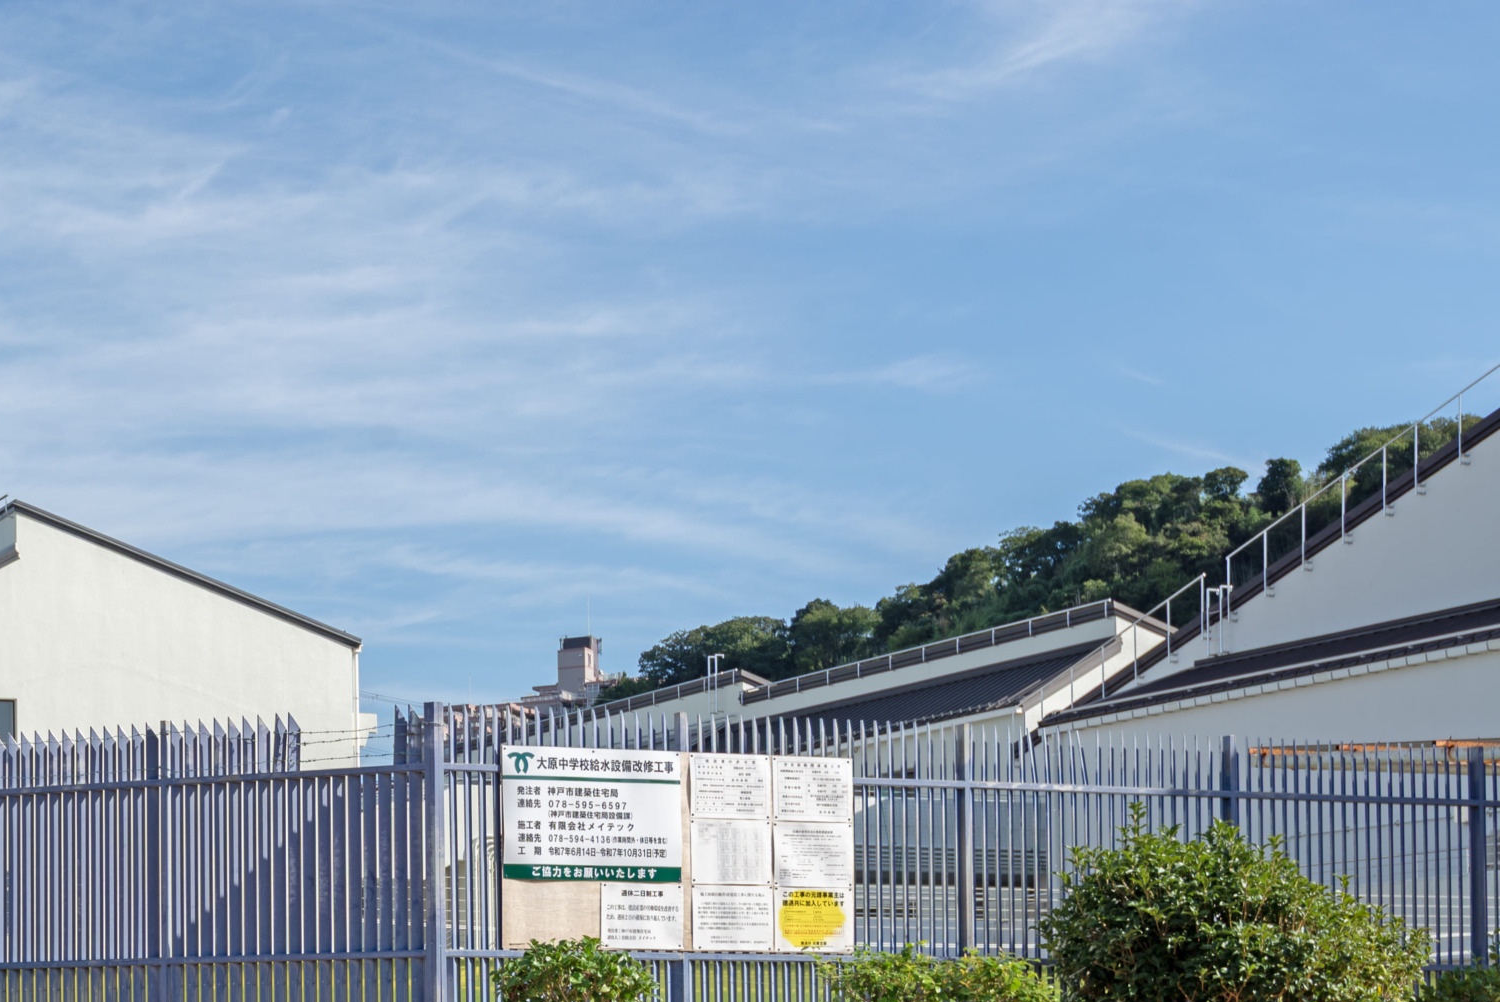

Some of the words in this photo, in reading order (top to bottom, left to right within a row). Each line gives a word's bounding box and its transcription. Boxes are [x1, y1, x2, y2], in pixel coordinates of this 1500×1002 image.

[536, 756, 674, 774] 大原中学校給水設備改修工事
[517, 785, 541, 796] 発注者
[547, 786, 619, 798] 神戸市建築住宅局
[517, 798, 541, 808] 連絡先
[548, 799, 627, 811] 078-595-6597
[517, 820, 541, 830] 施工者
[548, 821, 635, 832] 有限会社メイテック
[517, 833, 542, 843] 連絡先
[532, 866, 658, 880] ご協力をお願いいたします
[621, 889, 664, 898] 週休二日制工事
